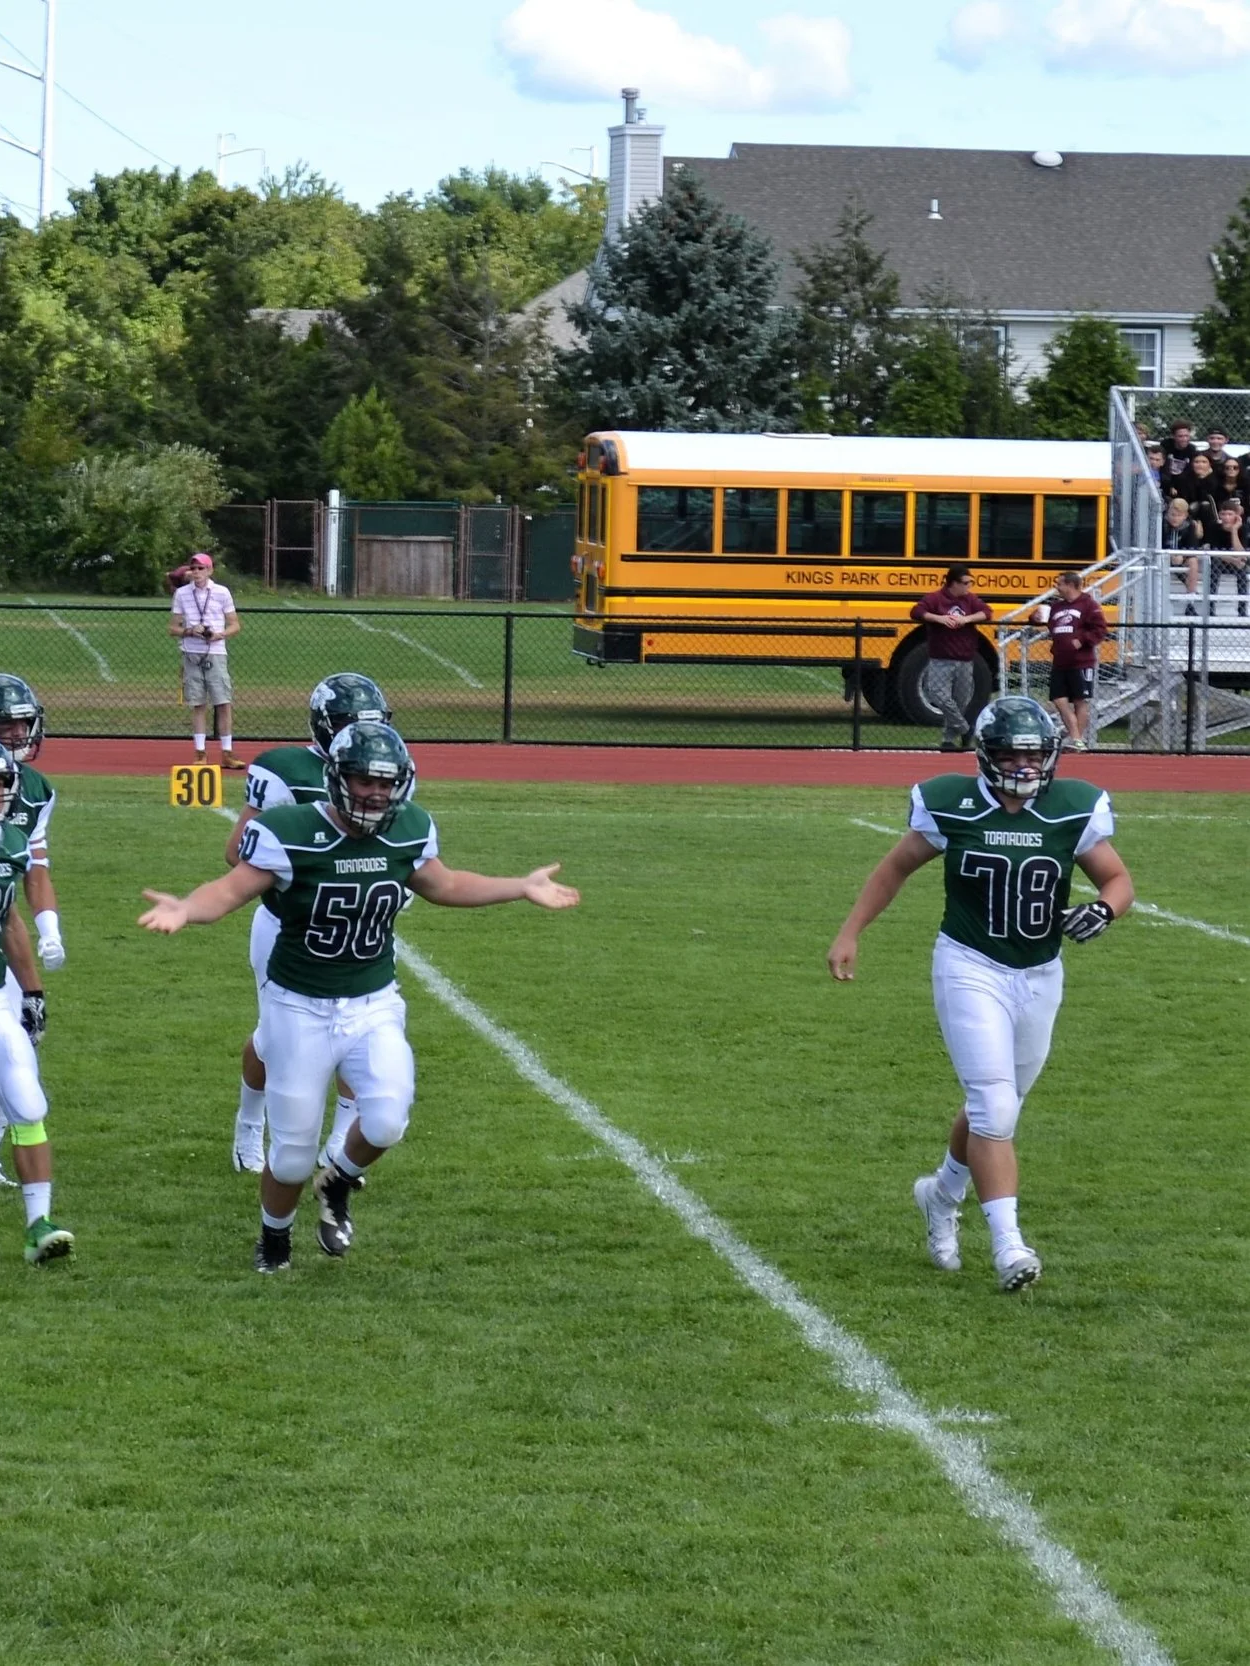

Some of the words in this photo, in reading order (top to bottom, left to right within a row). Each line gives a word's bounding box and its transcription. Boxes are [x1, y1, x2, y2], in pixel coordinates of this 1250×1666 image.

[785, 570, 835, 585] KINGS
[840, 571, 881, 586] PARK
[888, 572, 948, 587] CENTRA
[176, 767, 216, 806] 30
[983, 830, 1043, 847] TORNADOES
[334, 856, 389, 875] TORNADOES
[960, 850, 1062, 940] 78
[305, 880, 404, 960] 50
